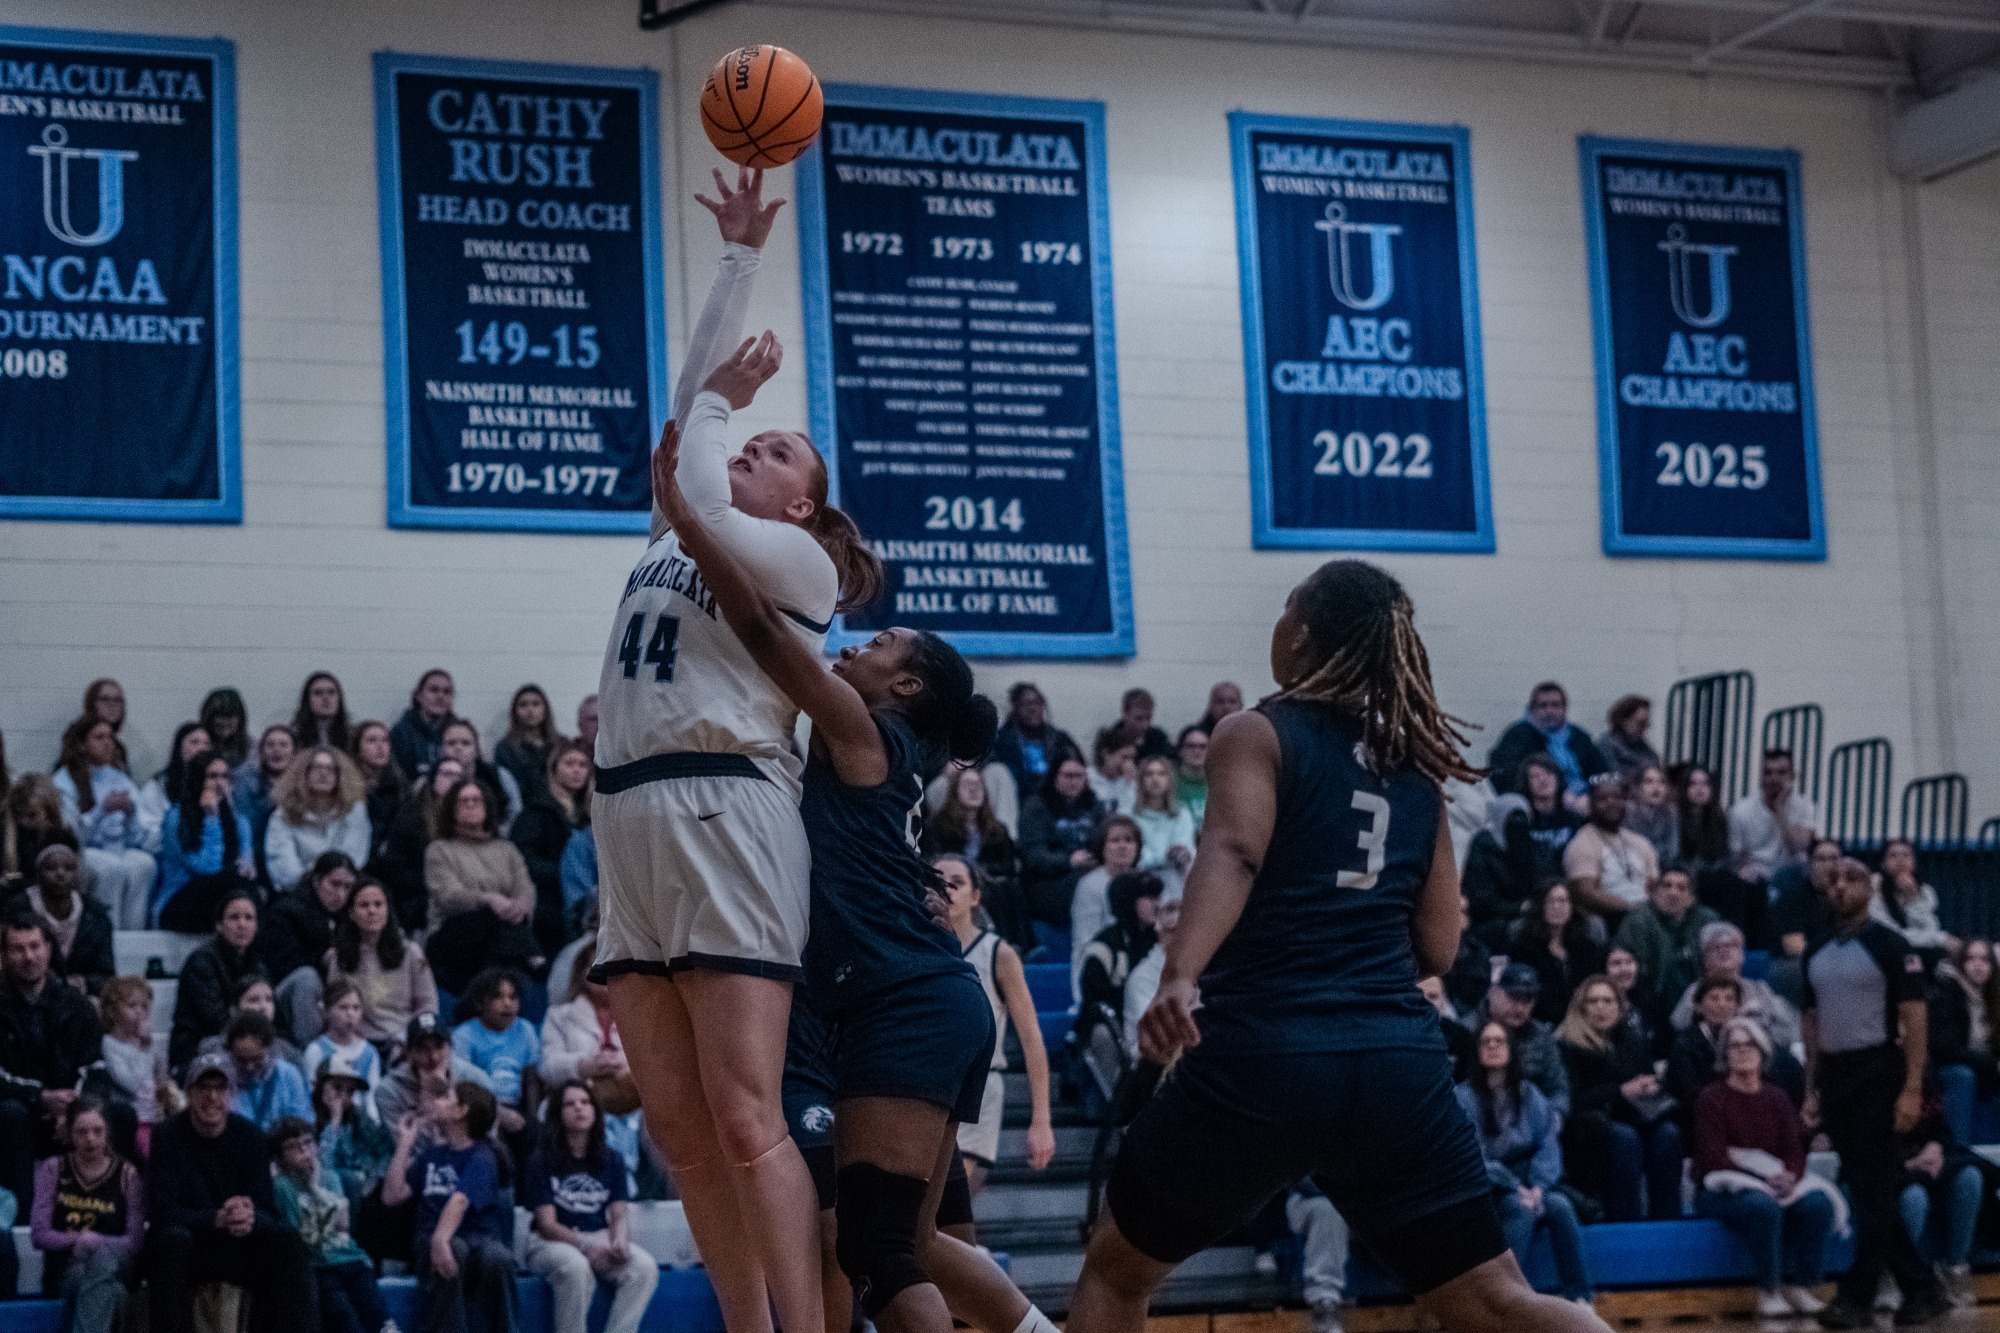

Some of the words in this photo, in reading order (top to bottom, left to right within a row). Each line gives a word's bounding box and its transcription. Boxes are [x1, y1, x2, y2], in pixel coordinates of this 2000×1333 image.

[0, 60, 206, 103] MACULATA
[51, 98, 186, 126] BASKETBALL
[427, 89, 611, 141] CATHY
[450, 138, 594, 189] RUSH
[829, 121, 1080, 171] IMMACULATA
[1257, 142, 1450, 184] IMMACULATA
[836, 164, 939, 189] WOMEN'S
[941, 170, 1079, 197] BASKETBALL
[1261, 174, 1343, 198] WOMEN'S
[1345, 180, 1449, 204] BASKETBALL
[417, 193, 510, 226] HEAD
[516, 200, 632, 232] COACH
[922, 195, 996, 219] TEAMS
[463, 237, 591, 264] IMMACULATA
[841, 230, 904, 256] 1972
[930, 235, 994, 261] 1973
[1020, 240, 1083, 266] 1974
[3, 254, 168, 306] NCAA
[481, 261, 575, 286] WOMEN'S
[467, 283, 591, 310] BASKETBALL
[455, 318, 601, 370] 149-15
[1321, 314, 1413, 362] AEC
[1662, 331, 1748, 378] AEC
[0, 348, 69, 380] 008
[1271, 359, 1465, 400] CHAMPIONS
[425, 378, 525, 403] NAISMITH
[527, 383, 637, 409] MEMORIAL
[1619, 372, 1797, 415] CHAMPIONS
[468, 404, 595, 430] BASKETBALL
[461, 428, 514, 450] HALL
[517, 431, 545, 451] OF
[549, 432, 604, 454] FAME
[1312, 429, 1434, 479] 2022
[447, 461, 620, 498] 1970-1977
[1655, 441, 1770, 491] 2025
[924, 494, 1026, 533] 2014
[972, 541, 1095, 566] MEMORIAL
[903, 566, 1048, 590] BASKETBALL
[895, 591, 959, 614] HALL
[961, 594, 995, 614] OF
[997, 595, 1061, 615] FAME
[618, 610, 681, 684] 44
[1335, 789, 1391, 891] 3
